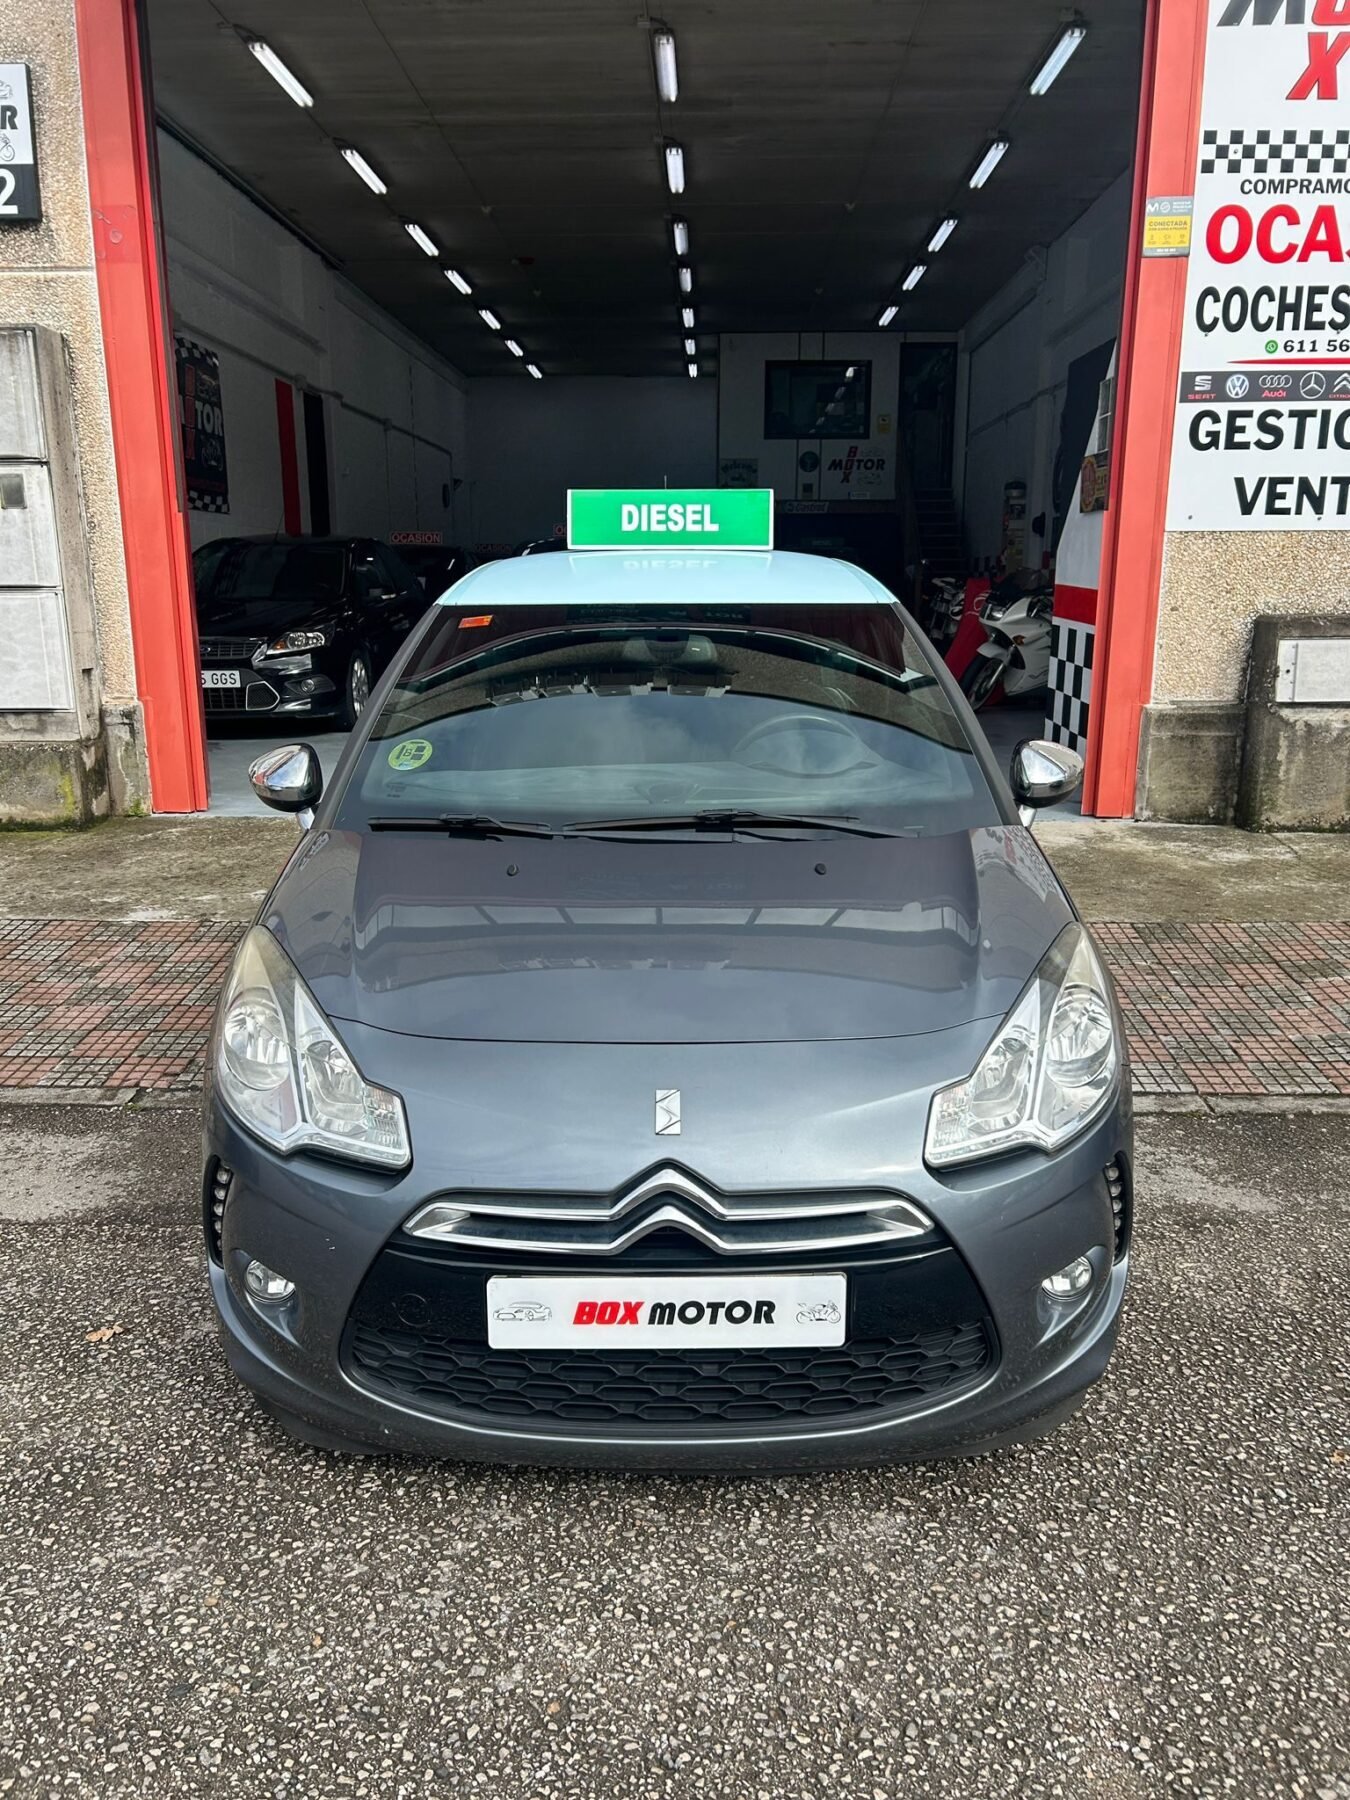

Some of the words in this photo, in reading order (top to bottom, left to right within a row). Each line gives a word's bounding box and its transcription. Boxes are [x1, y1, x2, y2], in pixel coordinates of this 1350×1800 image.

[1205, 204, 1350, 264] OCA
[1283, 339, 1318, 353] 611
[1261, 389, 1287, 398] Audi
[621, 503, 720, 532] DIESEL
[211, 672, 237, 685] GGS
[572, 1301, 646, 1326] BOX
[647, 1300, 776, 1325] MOTOR
